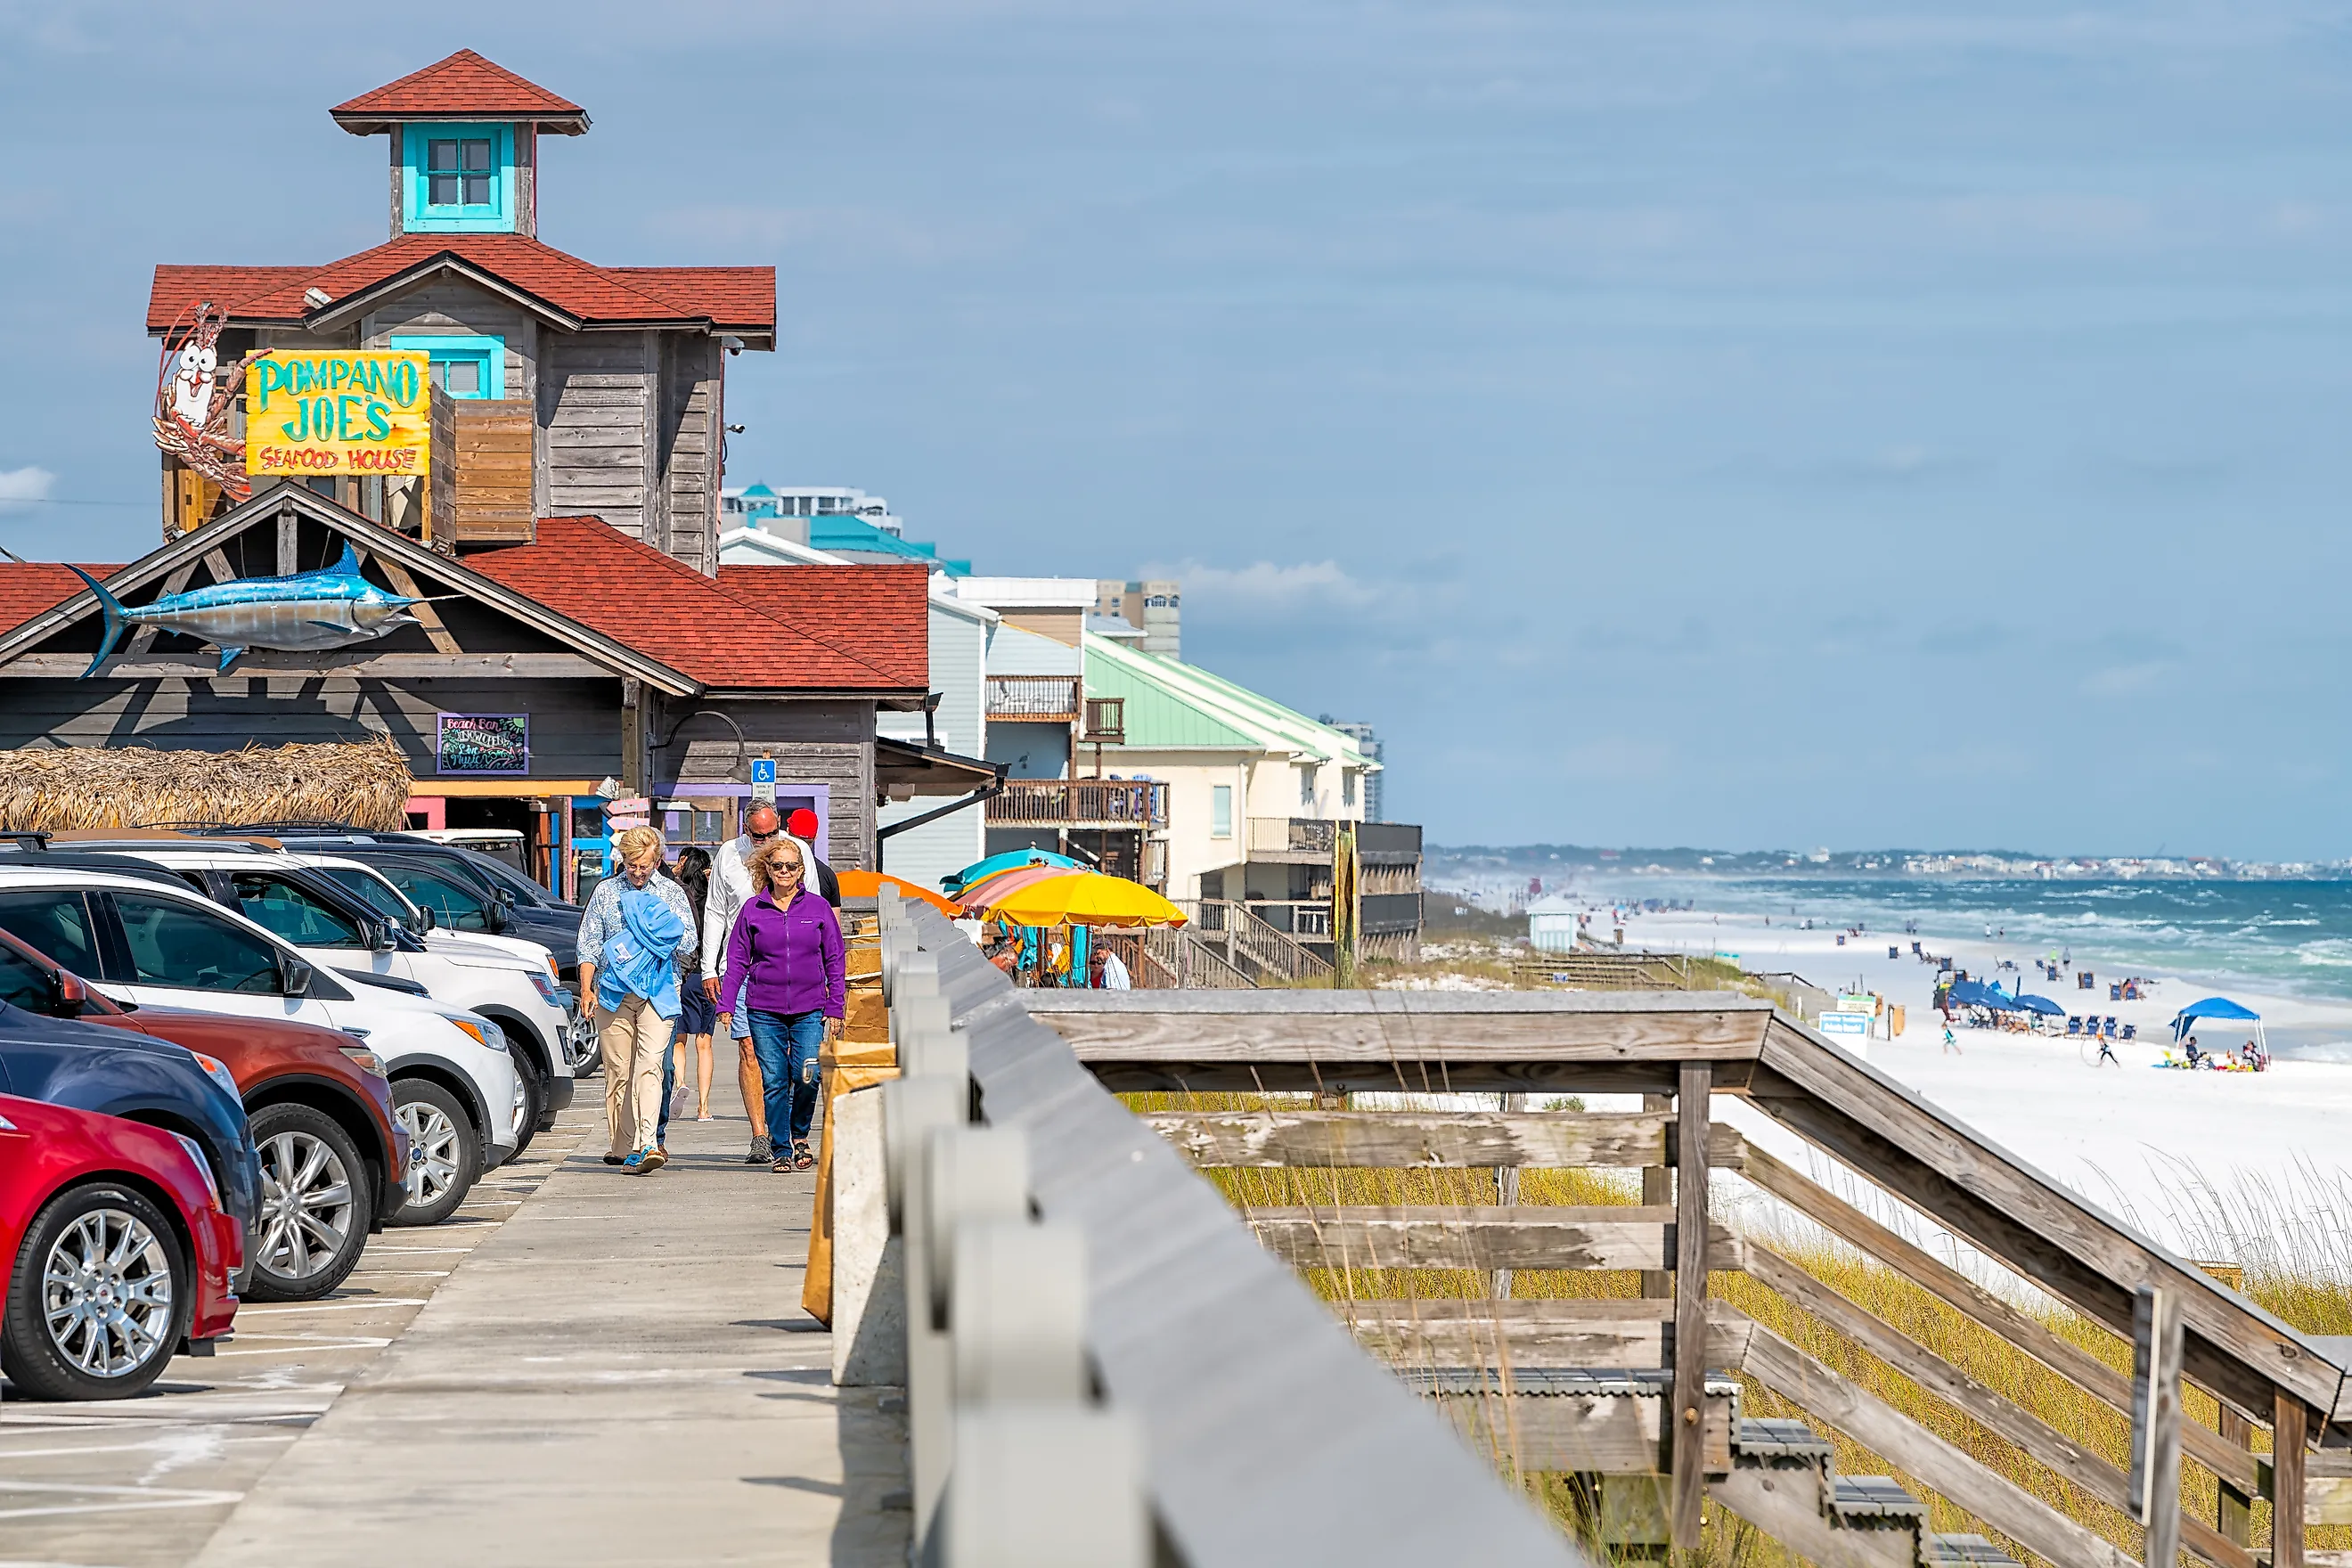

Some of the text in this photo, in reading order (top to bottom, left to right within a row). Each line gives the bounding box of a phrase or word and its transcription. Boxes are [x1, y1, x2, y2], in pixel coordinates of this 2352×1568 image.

[255, 359, 419, 413] POMPANO
[282, 394, 392, 442] JOE'S
[259, 445, 417, 470] SEAFOOD HOUSE
[447, 718, 476, 730] Beach
